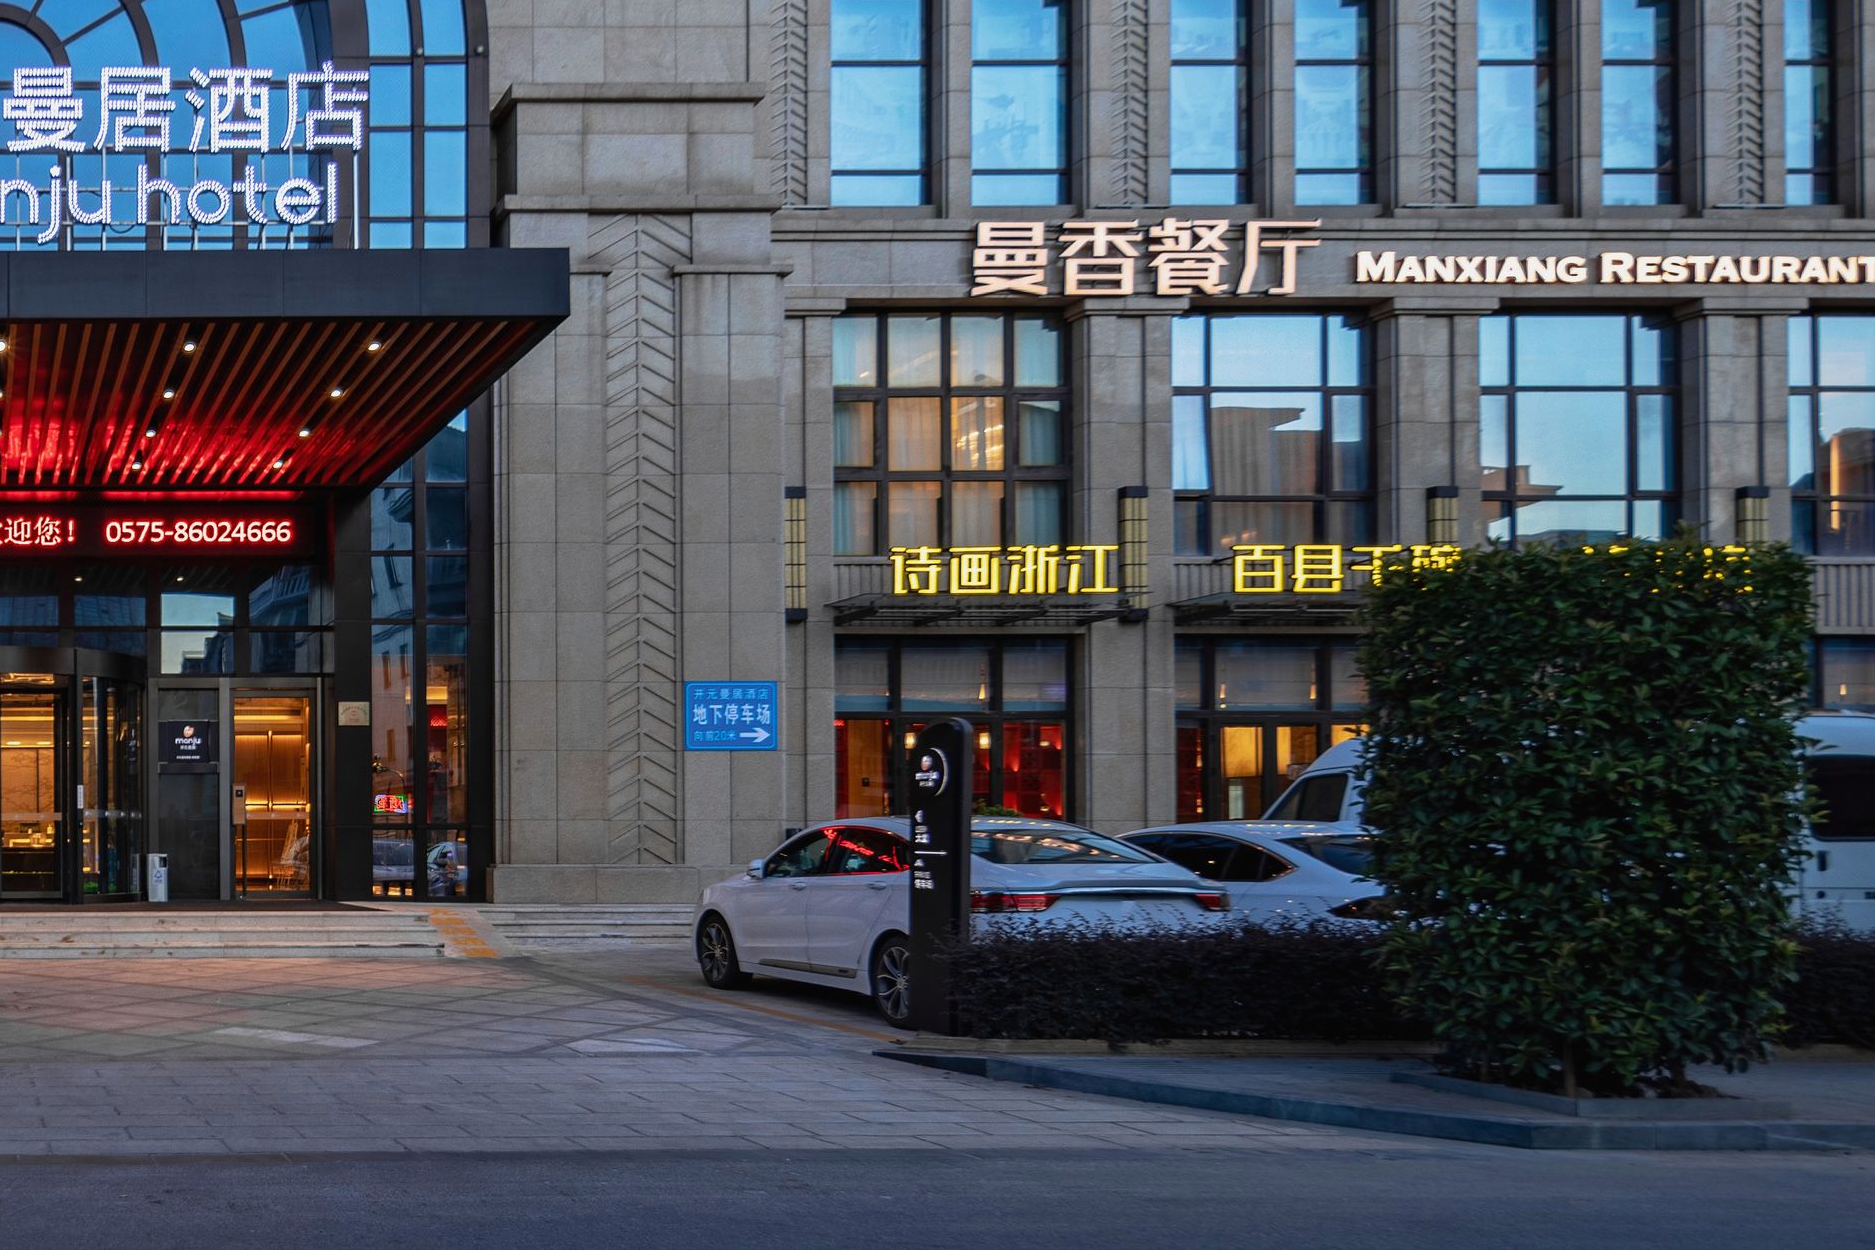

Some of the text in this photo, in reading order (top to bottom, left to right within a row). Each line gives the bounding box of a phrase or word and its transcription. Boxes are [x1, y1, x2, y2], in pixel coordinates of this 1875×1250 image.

[137, 162, 338, 225] hotel
[971, 217, 1322, 297] 曼香餐厅
[1355, 250, 1875, 284] MANXIANG RESTAURANT
[106, 521, 292, 543] 0575-86024666
[889, 545, 1119, 594] 诗画浙江
[693, 688, 769, 700] 开元曼居酒店
[693, 703, 771, 725] 地下停车场
[693, 731, 737, 742] 向前20米
